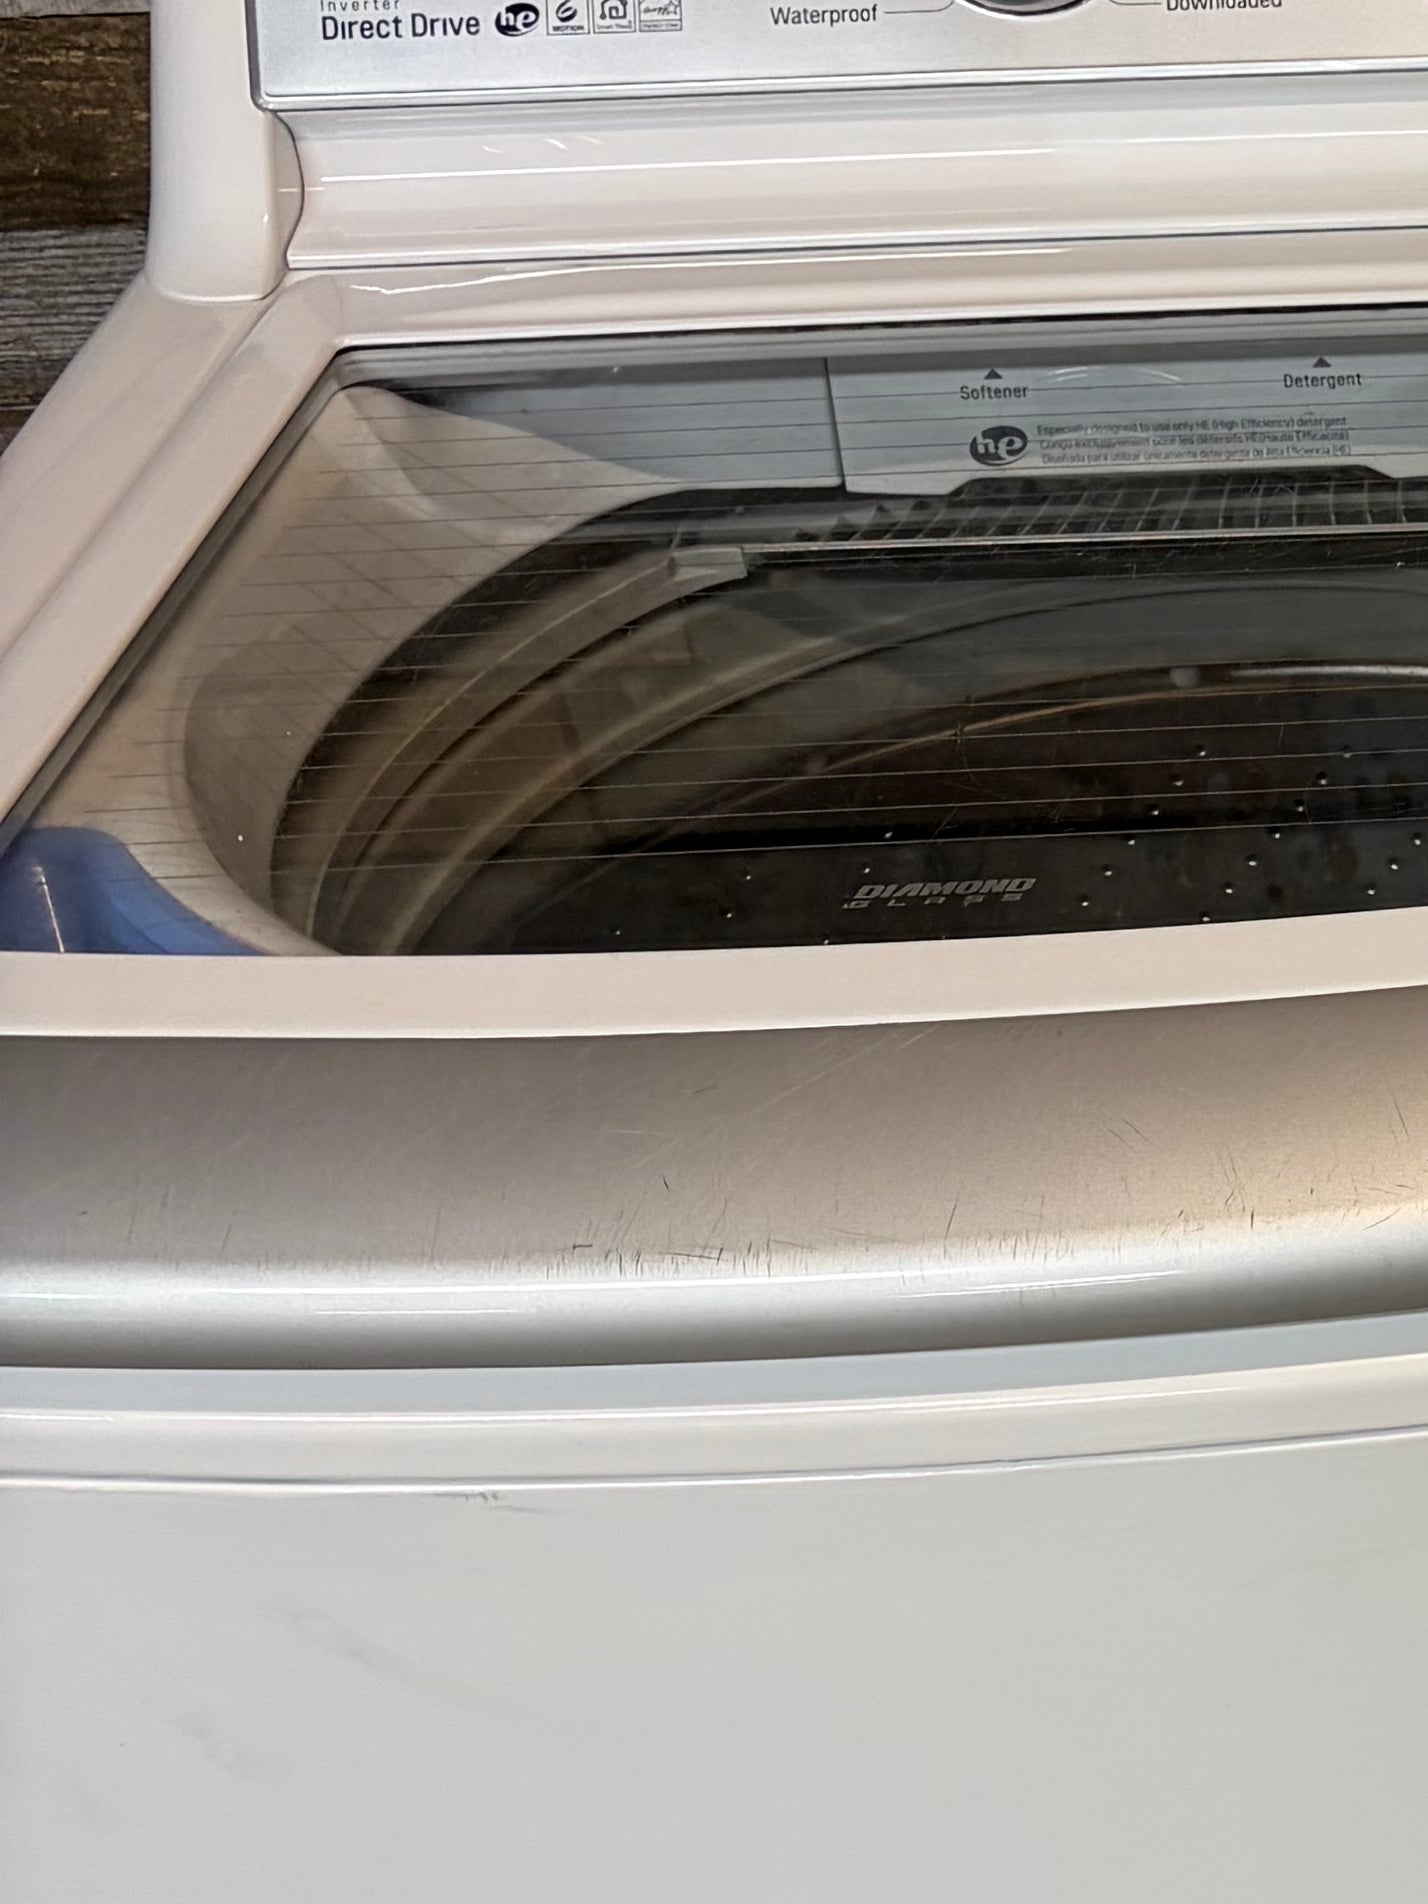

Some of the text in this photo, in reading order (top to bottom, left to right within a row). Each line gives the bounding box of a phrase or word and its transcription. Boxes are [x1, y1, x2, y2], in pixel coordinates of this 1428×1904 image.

[321, 12, 480, 40] Direct Drive
[770, 4, 878, 27] Waterproof
[1283, 373, 1362, 389] Detergent
[960, 385, 1028, 401] Softener
[856, 877, 1036, 899] DIAMOND
